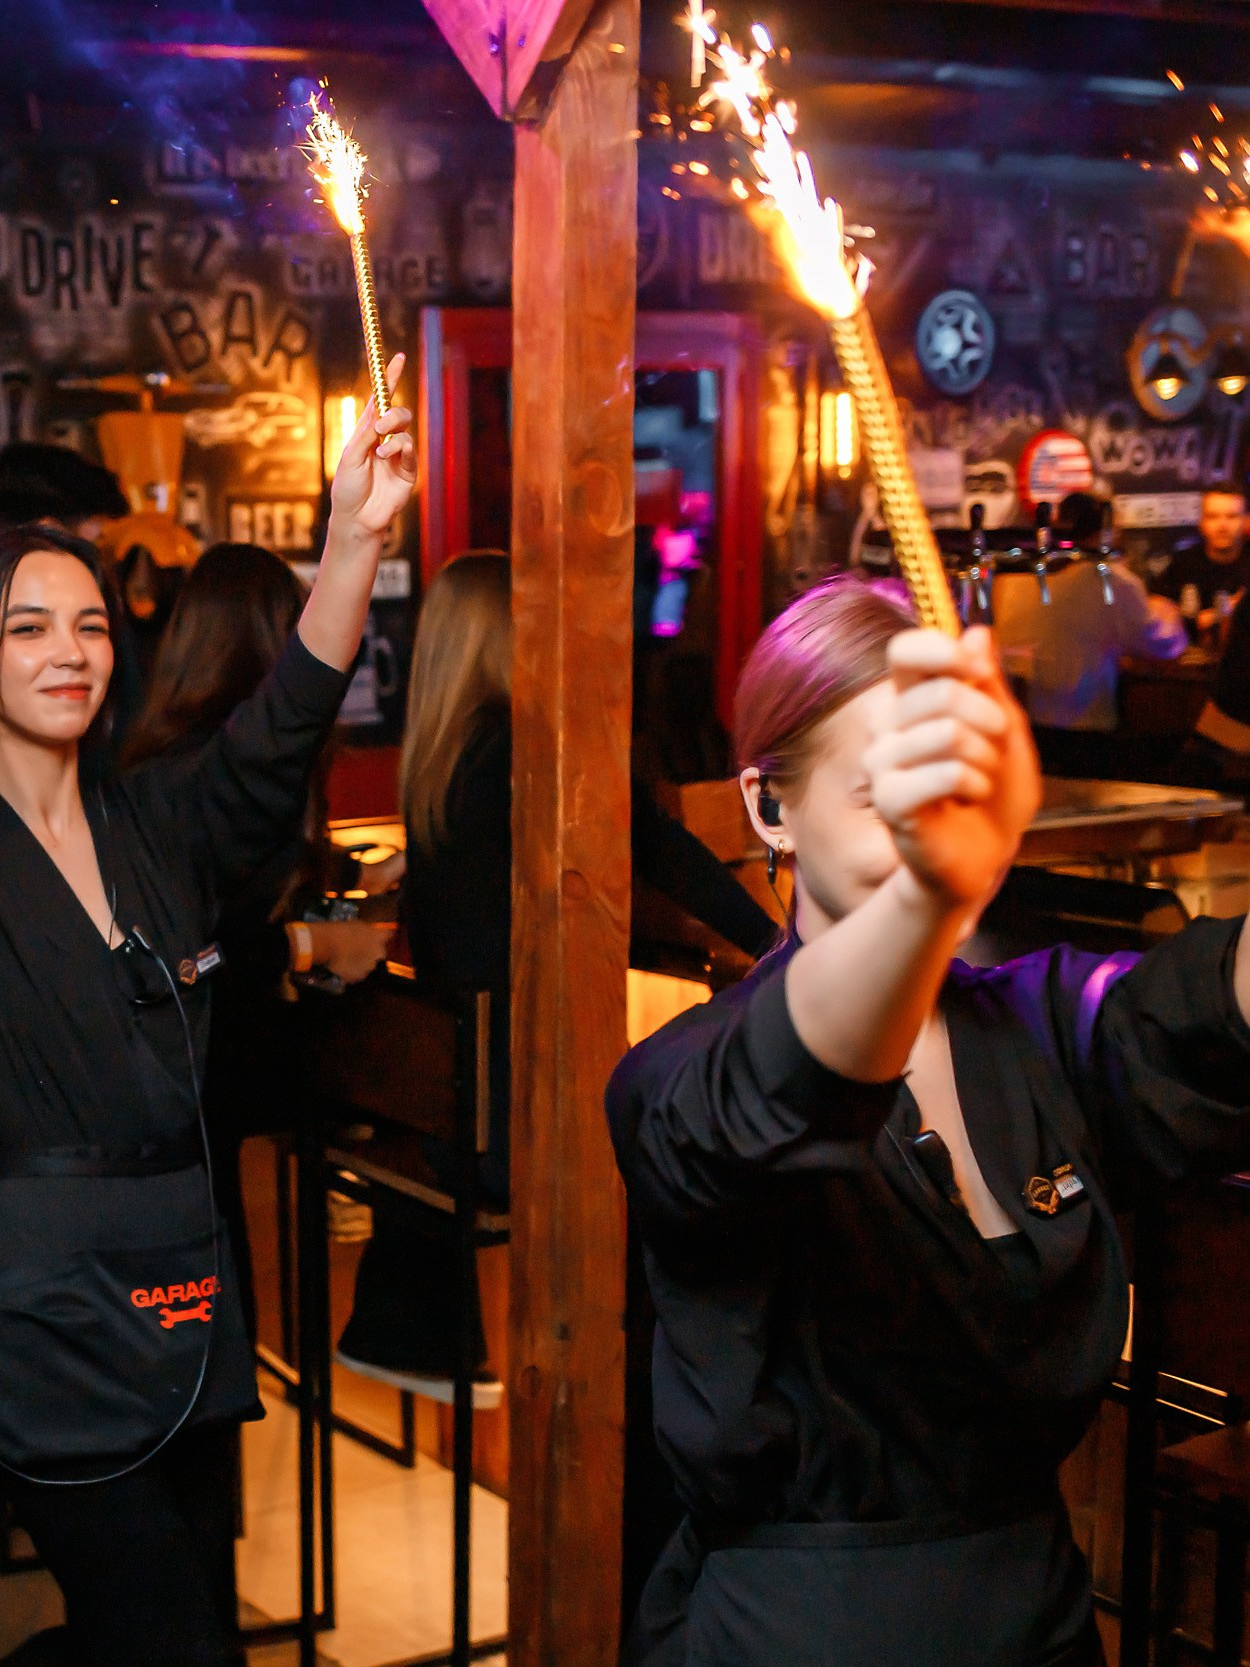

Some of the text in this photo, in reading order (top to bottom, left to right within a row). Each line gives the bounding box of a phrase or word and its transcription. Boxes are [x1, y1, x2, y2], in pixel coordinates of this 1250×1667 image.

[20, 222, 156, 310] DRIVE
[289, 252, 446, 290] GAAGE
[159, 289, 311, 384] BAR
